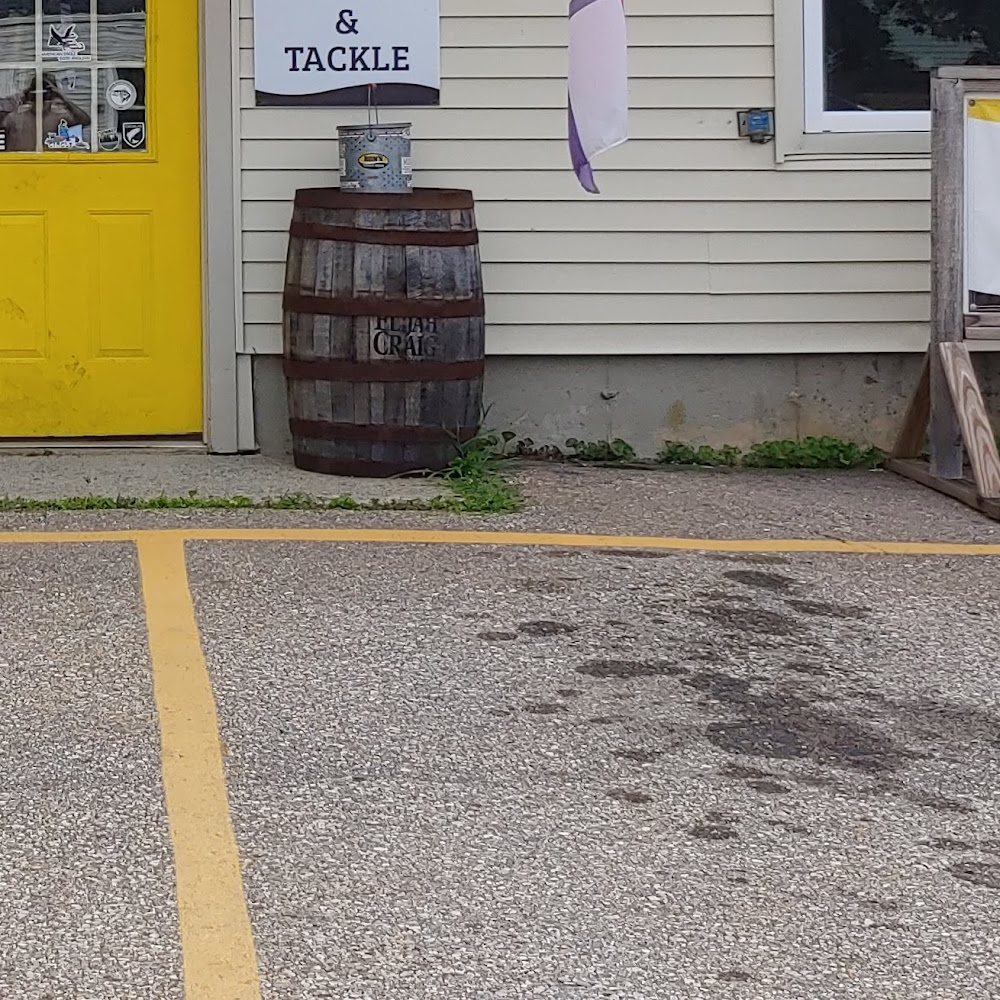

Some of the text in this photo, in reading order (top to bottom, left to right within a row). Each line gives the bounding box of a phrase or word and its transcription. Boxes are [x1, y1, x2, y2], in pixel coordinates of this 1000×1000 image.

[335, 9, 359, 34] &
[284, 46, 410, 71] TACKLE
[374, 331, 436, 356] CRAIG
